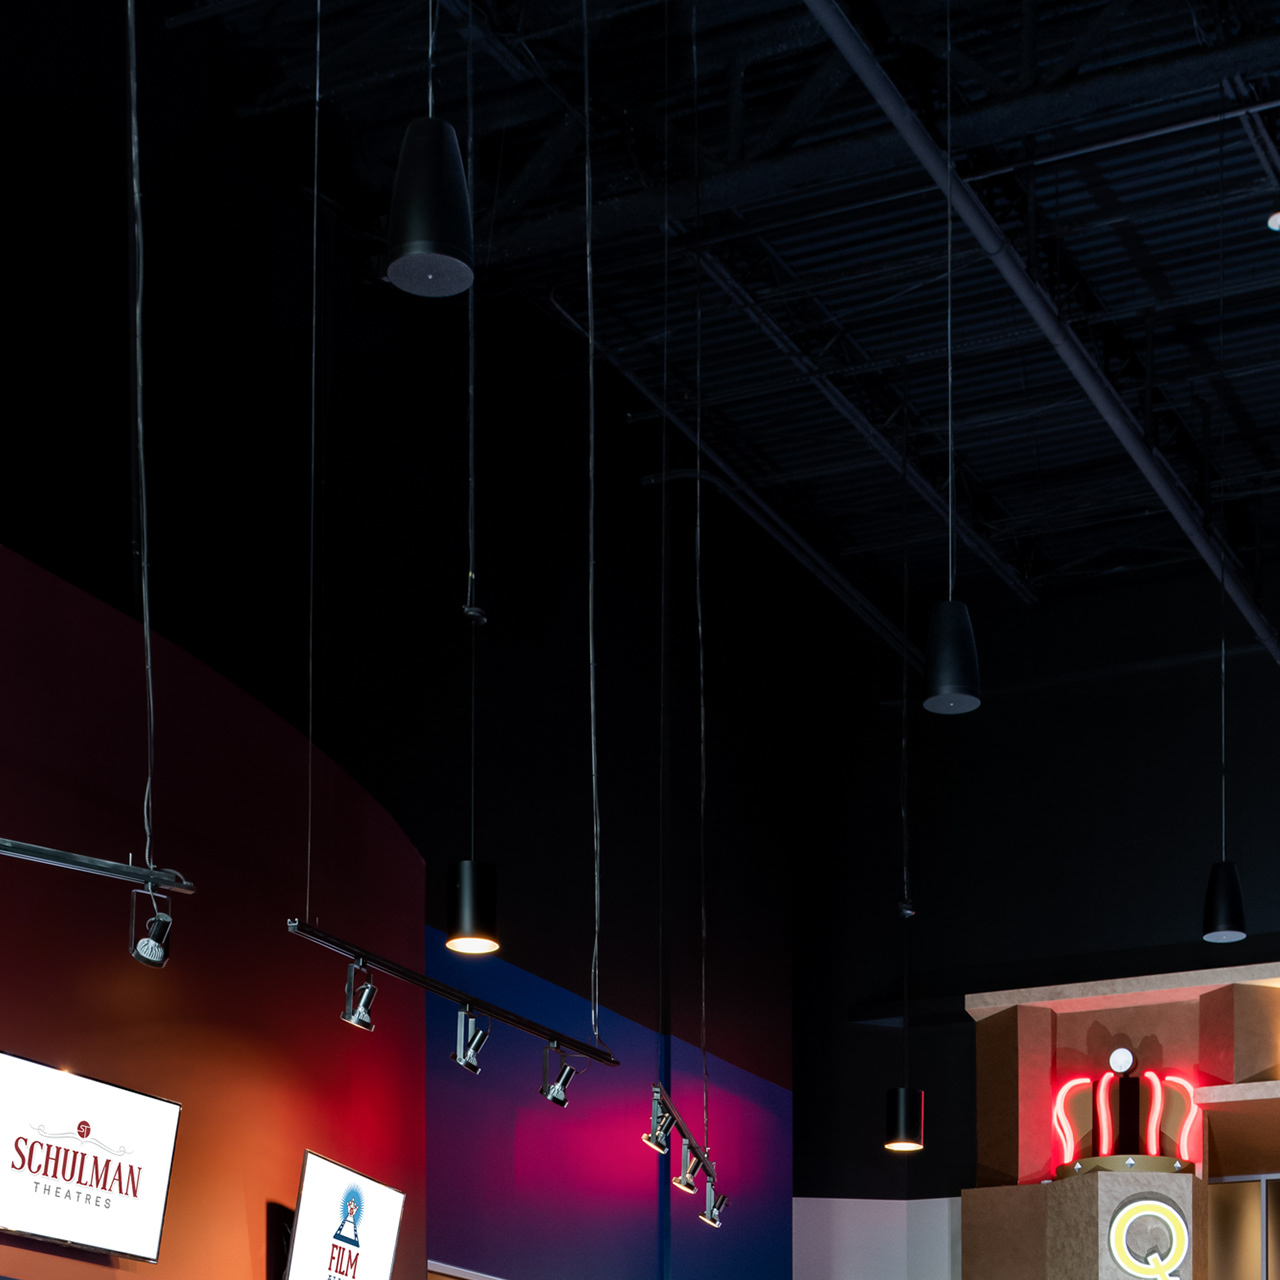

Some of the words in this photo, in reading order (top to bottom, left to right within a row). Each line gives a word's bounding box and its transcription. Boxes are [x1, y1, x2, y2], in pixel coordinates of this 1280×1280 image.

[11, 1136, 142, 1198] SCHULMAN
[33, 1181, 112, 1209] THEATRES
[328, 1243, 359, 1279] FILM
